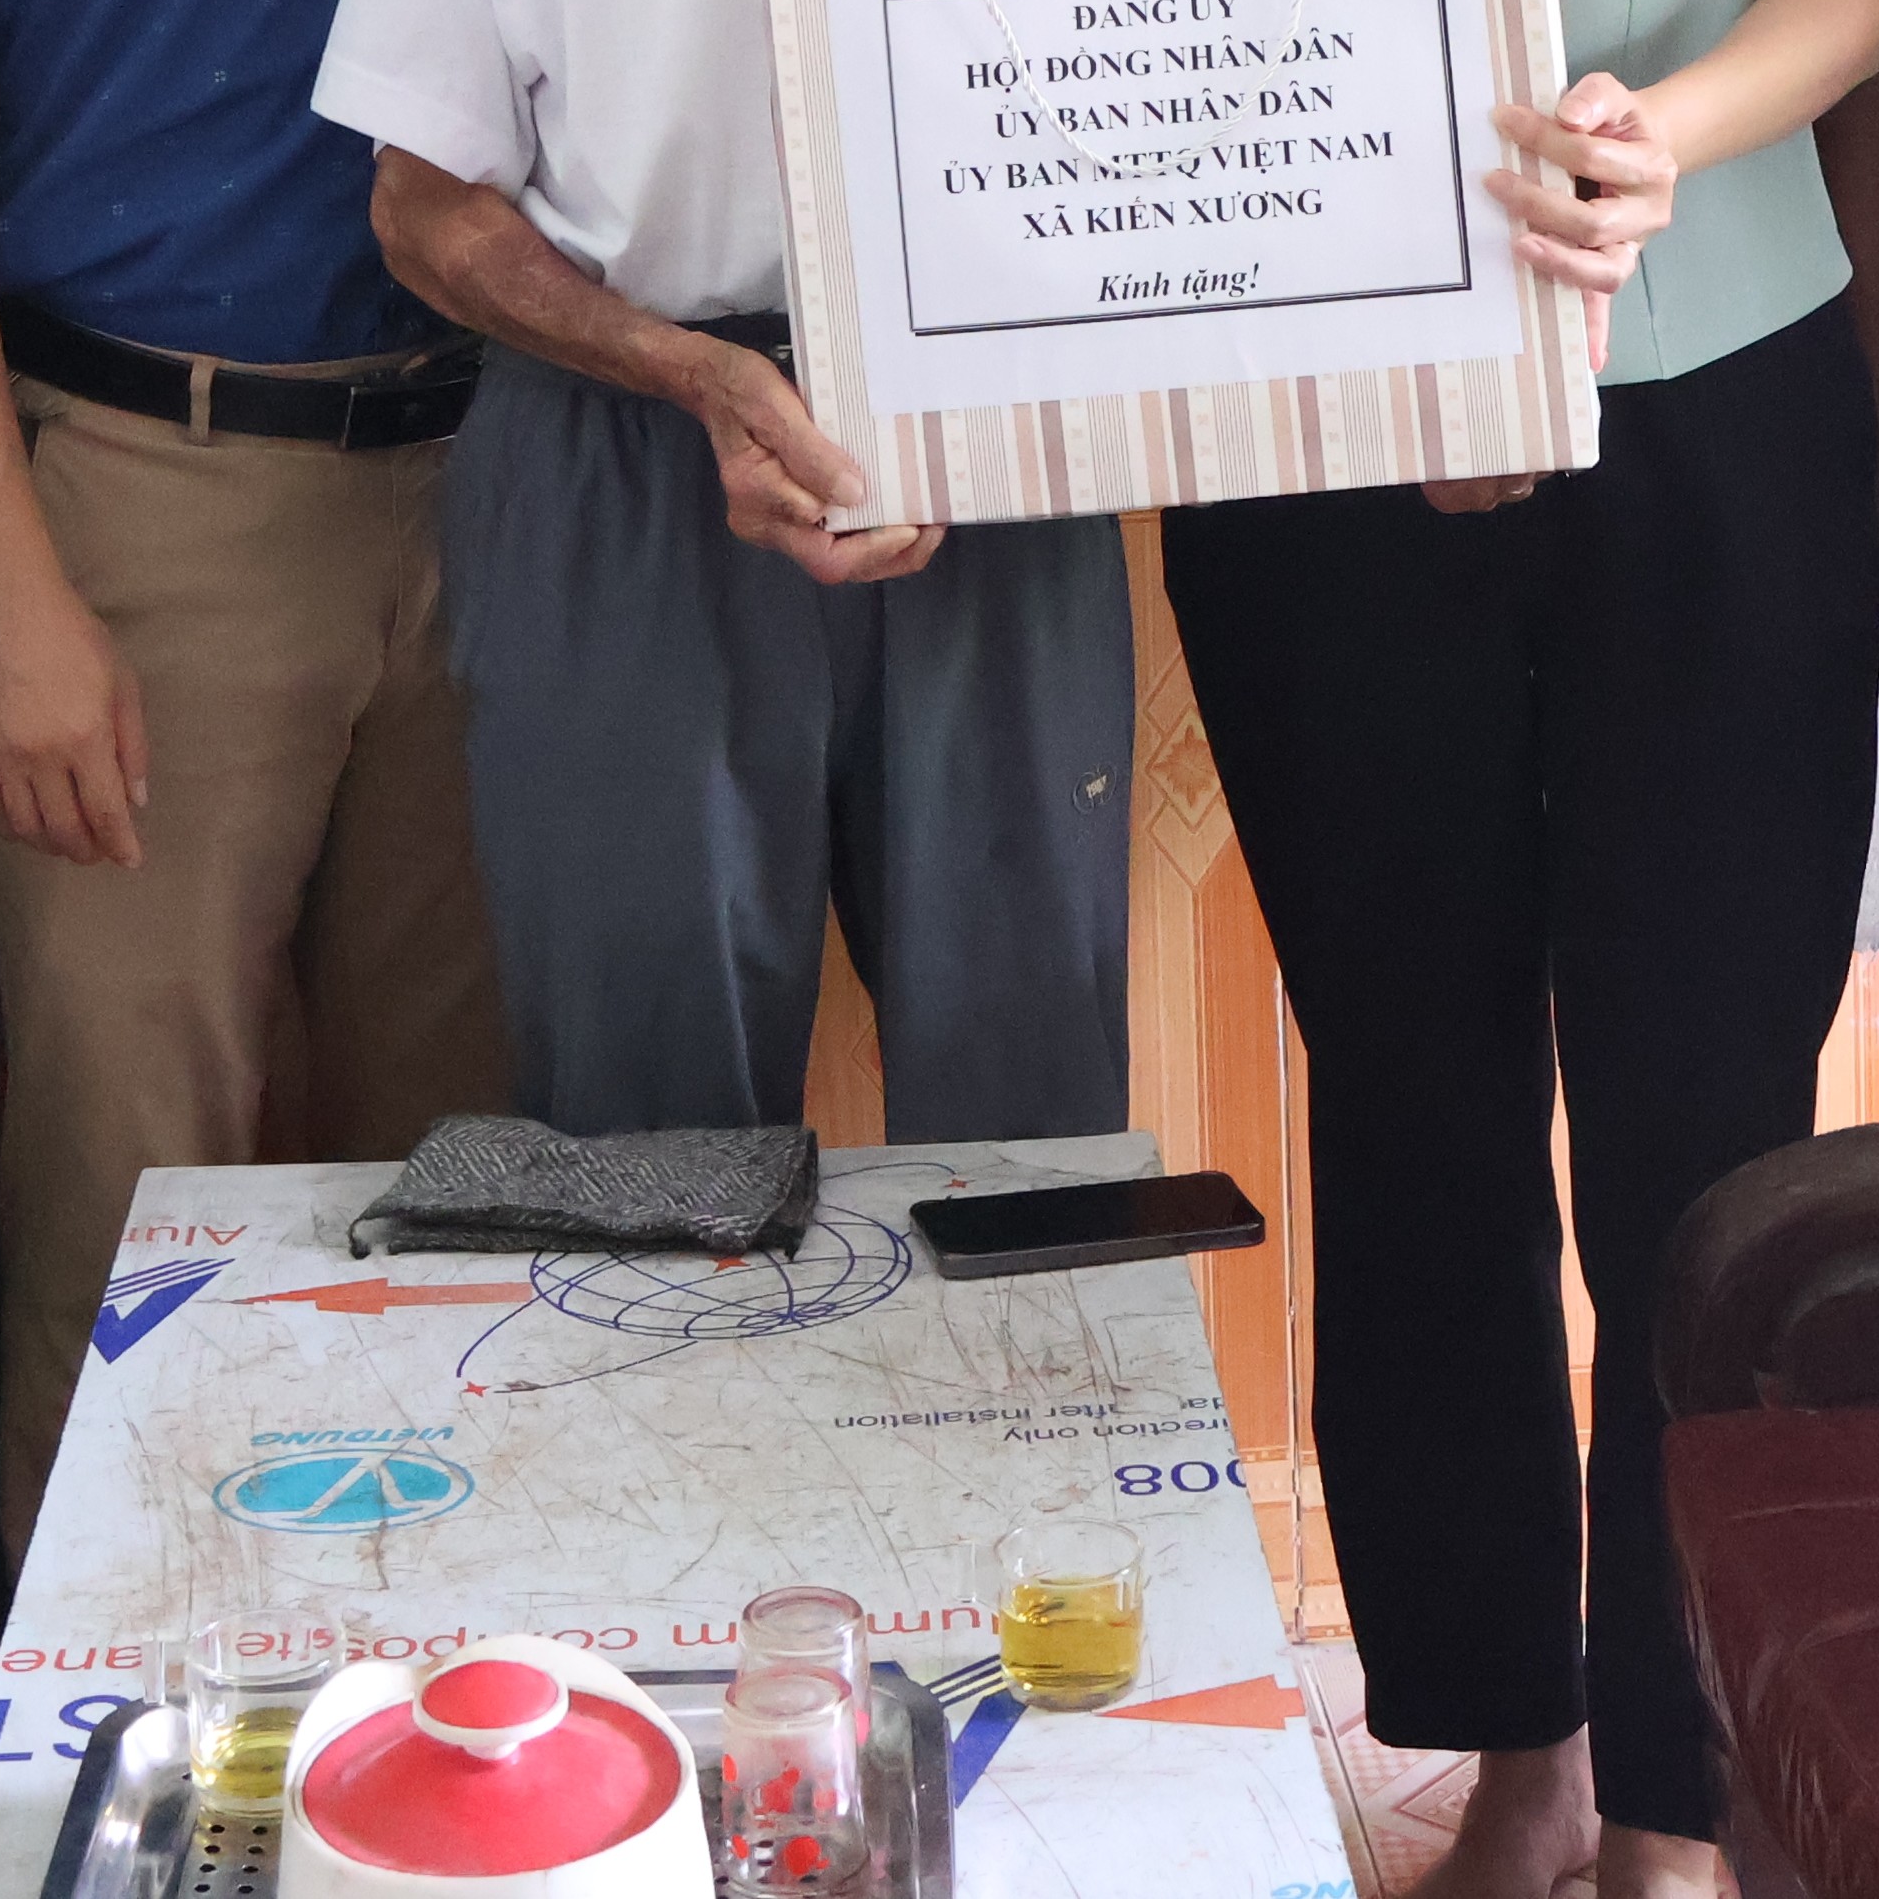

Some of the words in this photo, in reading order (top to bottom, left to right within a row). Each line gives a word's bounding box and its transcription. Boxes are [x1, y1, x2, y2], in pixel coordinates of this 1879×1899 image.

[1045, 46, 1151, 83] ĐỒNG
[1163, 35, 1267, 73] NHÂN
[995, 104, 1042, 138] ỦY
[1056, 103, 1130, 132] BAN
[1142, 87, 1245, 126] NHÂN
[1259, 80, 1334, 116] DÂN
[943, 161, 993, 194] ỦY
[1006, 158, 1079, 189] BAN
[1211, 138, 1297, 174] VIỆT
[1309, 132, 1394, 163] NAM
[1023, 204, 1074, 239] XÃ
[1085, 196, 1175, 234] KIẾN
[1188, 189, 1323, 226] XƯƠNG
[1097, 271, 1170, 302] Kính
[1182, 263, 1260, 300] tặng!
[250, 1426, 455, 1446] VIETDUNG
[834, 1406, 1031, 1429] installation
[1004, 1426, 1079, 1444] only
